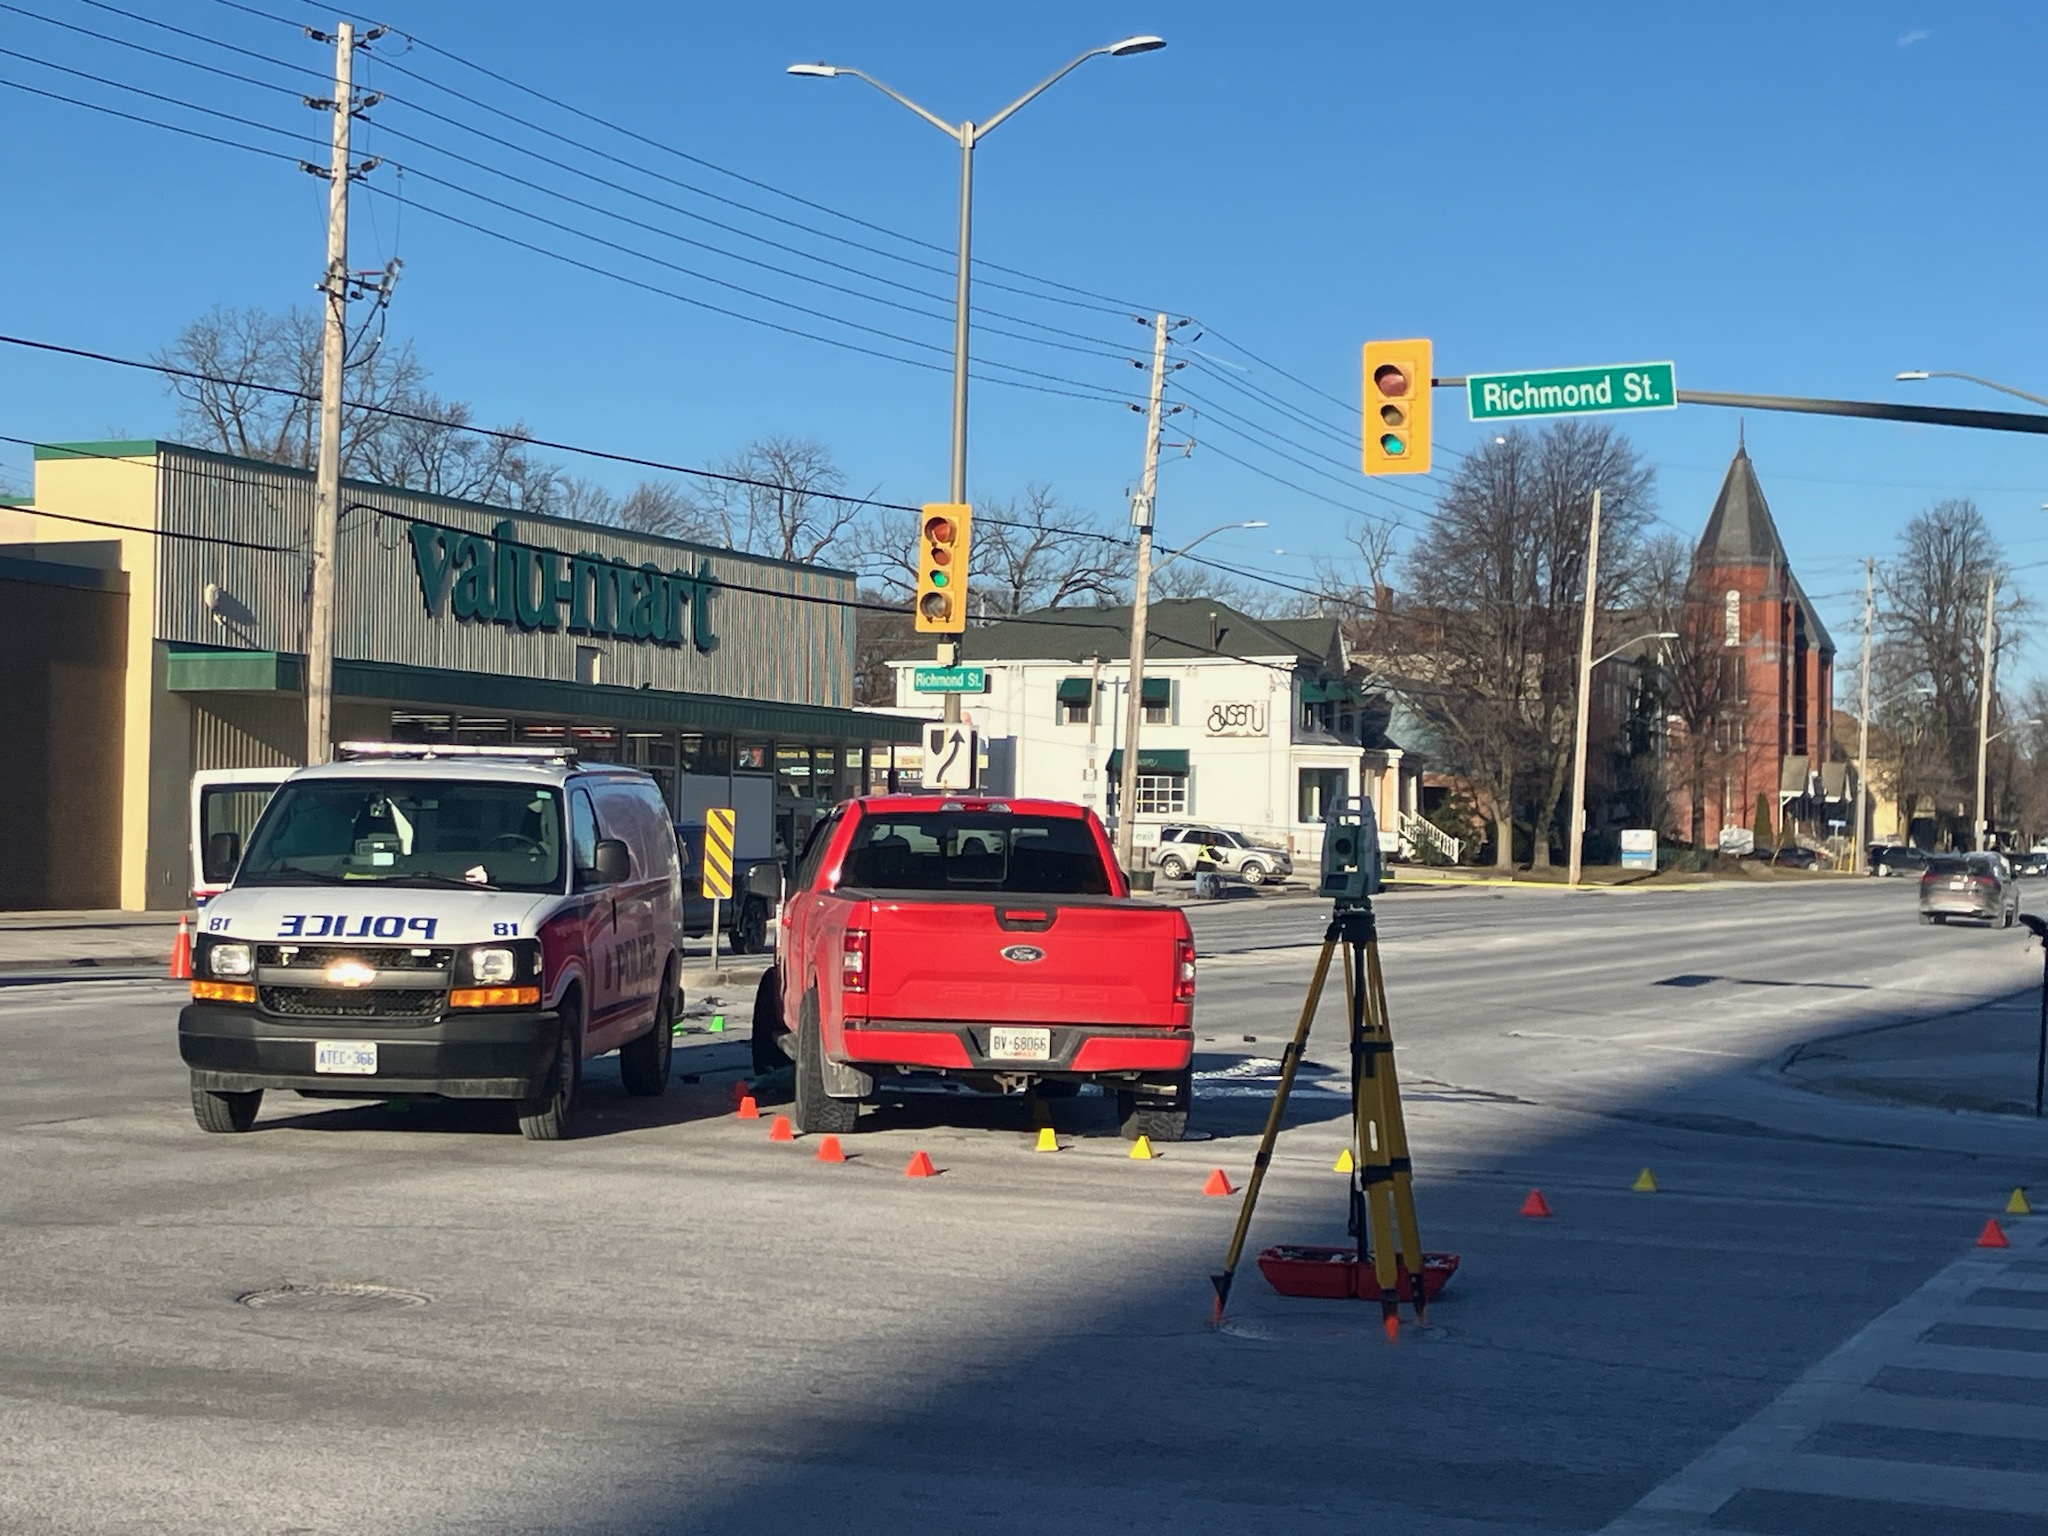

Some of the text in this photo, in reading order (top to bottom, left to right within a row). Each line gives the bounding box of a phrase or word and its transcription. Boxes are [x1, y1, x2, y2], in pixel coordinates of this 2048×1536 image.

[1483, 372, 1660, 412] Richmond St.
[409, 519, 719, 653] valu-mart
[915, 672, 964, 687] Richmond
[209, 917, 232, 931] 81
[493, 922, 519, 936] 81
